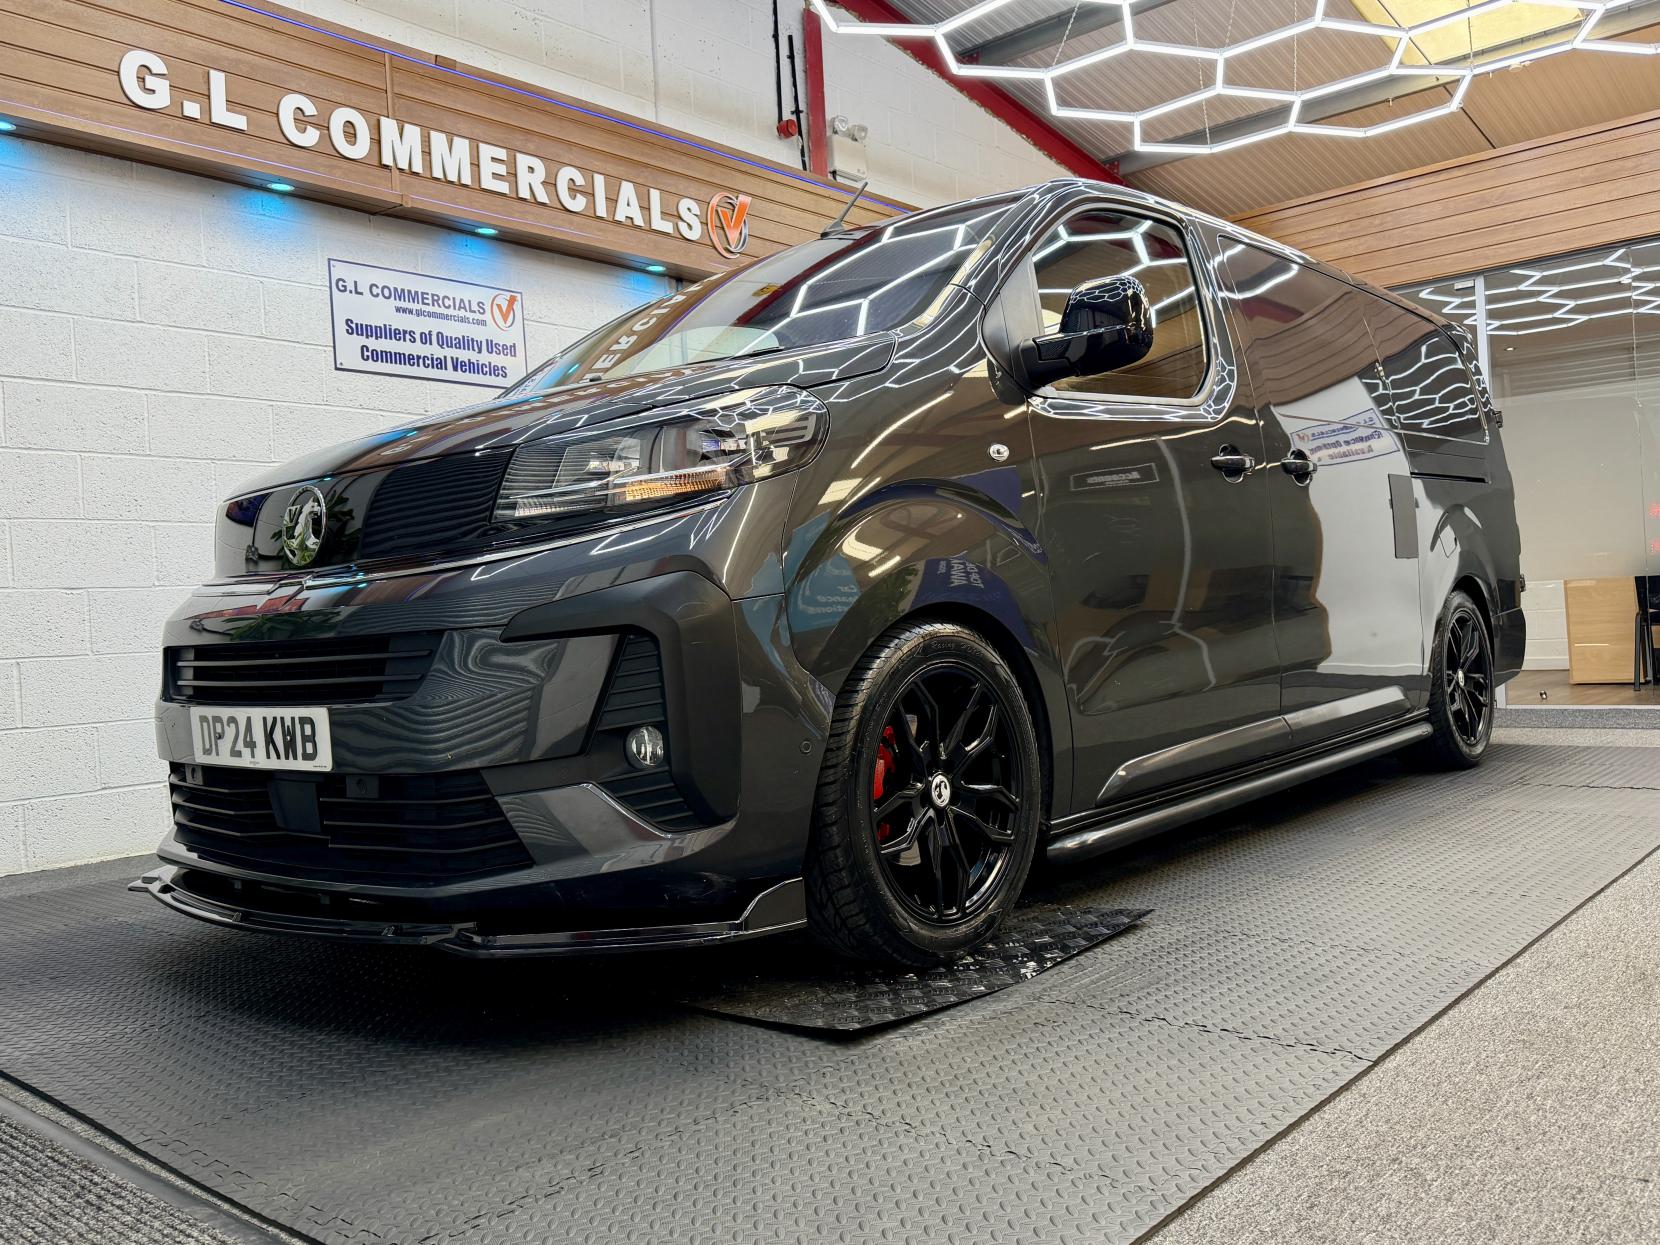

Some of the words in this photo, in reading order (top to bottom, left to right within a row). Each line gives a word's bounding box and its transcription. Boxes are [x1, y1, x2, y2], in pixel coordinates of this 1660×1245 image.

[119, 50, 248, 131] G.L
[278, 93, 701, 242] COMMERCIALS
[335, 277, 364, 296] G.L
[369, 282, 487, 316] COMMERCIALS
[394, 304, 488, 327] www.glcommercials.com
[345, 318, 416, 344] Suppliers
[419, 329, 433, 346] of
[436, 331, 483, 355] Quality
[486, 338, 517, 358] Used
[360, 344, 448, 371] Commercial
[450, 356, 508, 379] Vehicles
[198, 714, 257, 759] DP24
[262, 715, 318, 762] KWB
